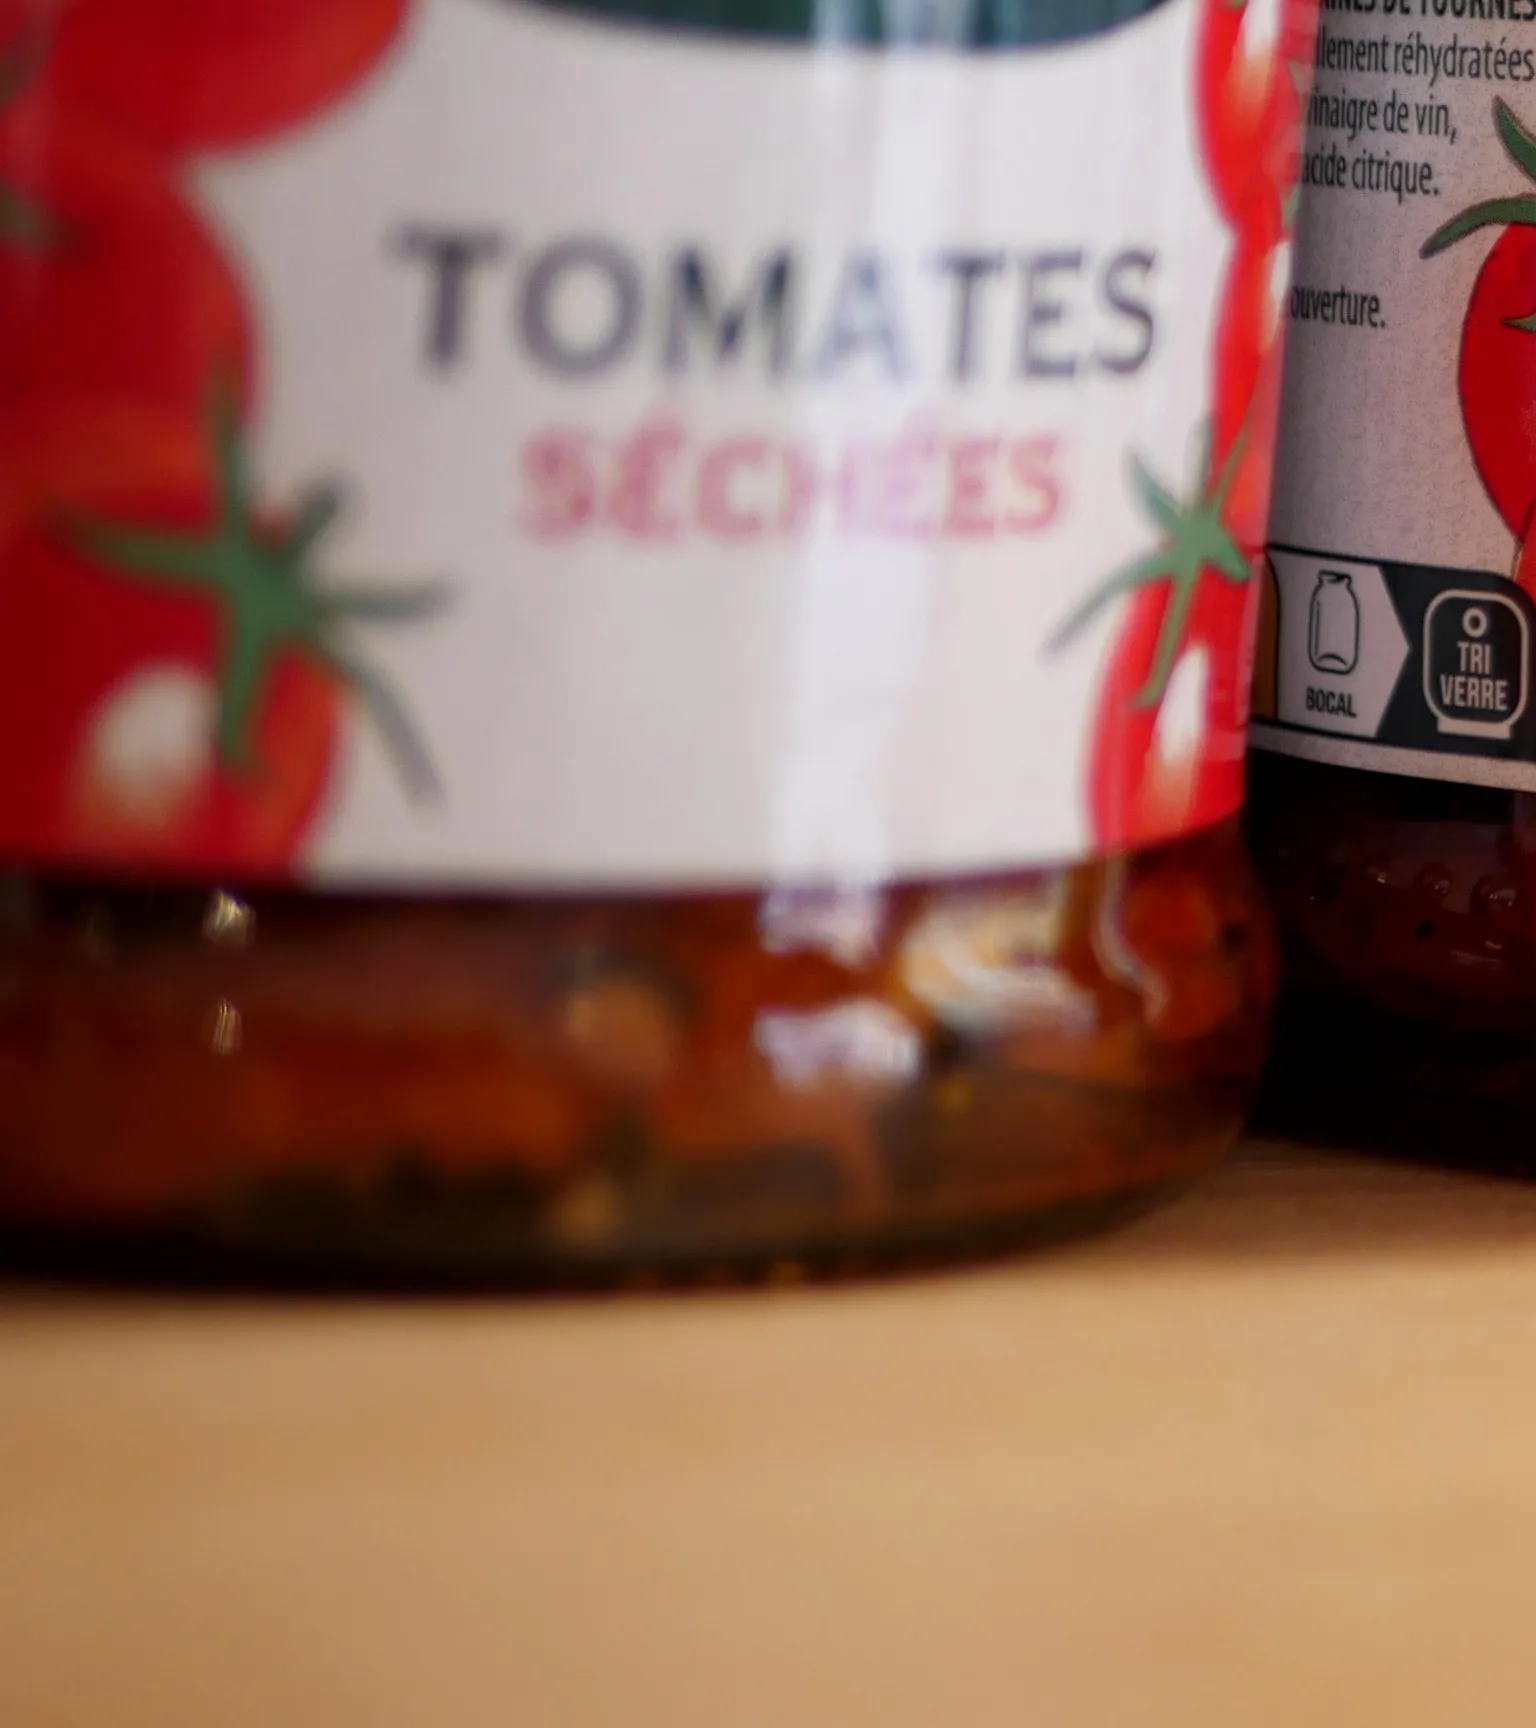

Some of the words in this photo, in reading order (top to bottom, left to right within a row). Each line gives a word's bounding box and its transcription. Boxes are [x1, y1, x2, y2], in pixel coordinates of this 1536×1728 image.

[1395, 29, 1536, 87] réhydratées
[1383, 89, 1409, 134] de
[1415, 95, 1458, 145] vin,
[1352, 148, 1440, 206] citrique.
[388, 217, 1164, 386] TOMATES
[1456, 641, 1492, 674] TRI
[1305, 684, 1358, 719] BOCAL
[1440, 674, 1509, 712] VERRE
